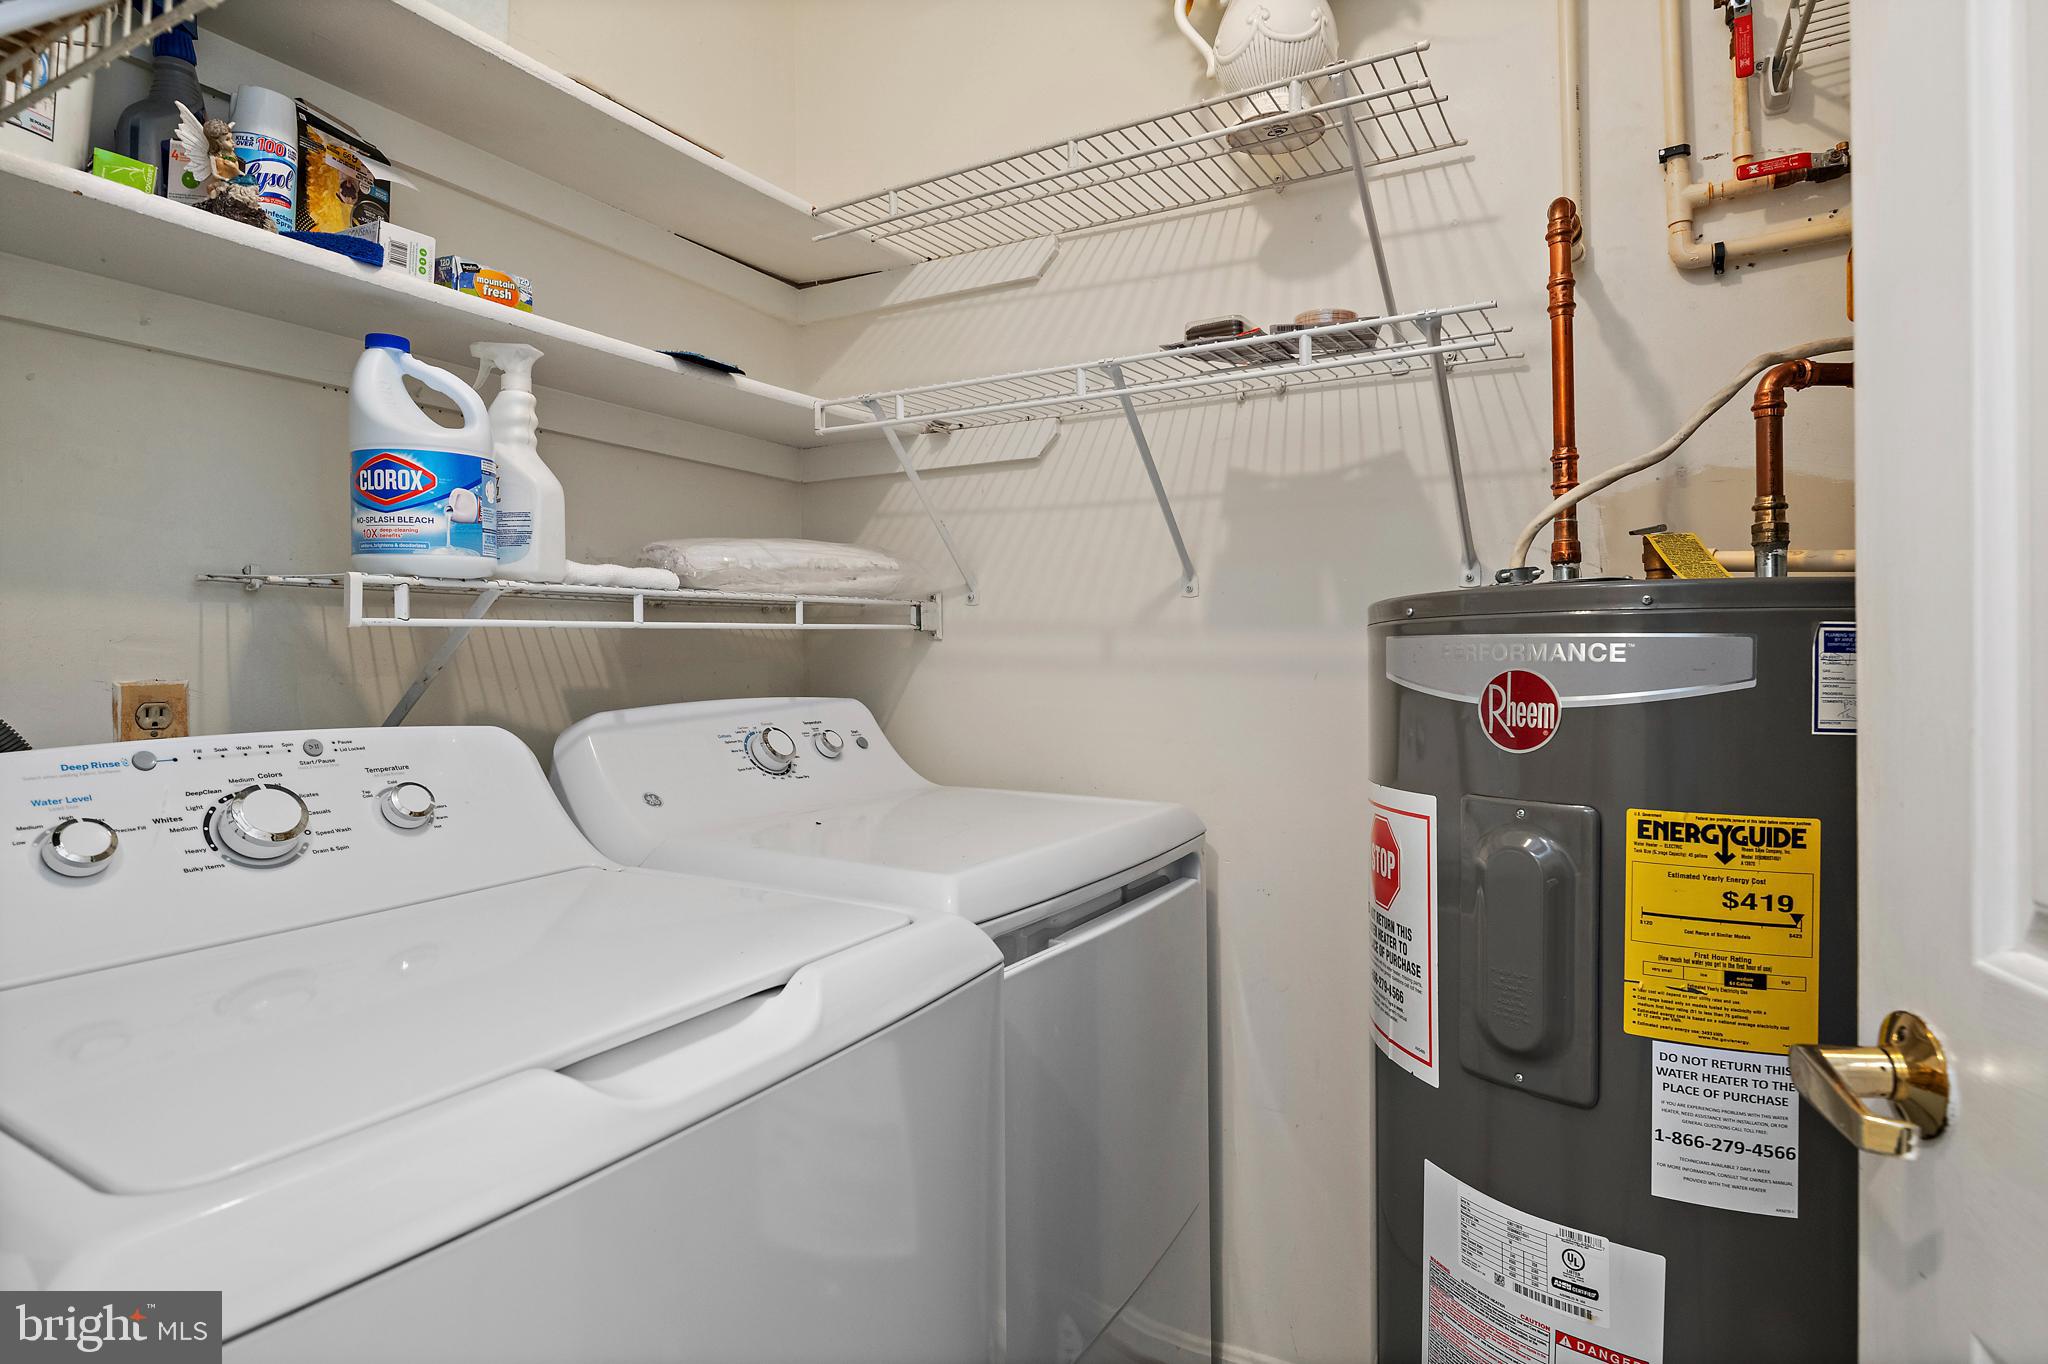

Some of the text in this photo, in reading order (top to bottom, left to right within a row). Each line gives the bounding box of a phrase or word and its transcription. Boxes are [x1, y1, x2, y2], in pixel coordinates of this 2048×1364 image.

[257, 137, 286, 157] 100
[171, 149, 179, 160] 4
[246, 162, 293, 195] Lysol
[440, 258, 450, 267] 120
[476, 276, 515, 290] mountain
[482, 285, 513, 300] fresh
[358, 469, 423, 491] CLOROX
[397, 516, 435, 525] BLEACH
[363, 528, 378, 538] 10X
[1488, 671, 1556, 738] Rheem
[60, 761, 121, 773] Deep Rinse
[299, 758, 336, 766] Start/Pause
[364, 764, 410, 774] Temperature
[228, 777, 255, 785] Medium
[257, 771, 283, 780] Colors
[185, 788, 223, 797] DeepClean
[30, 799, 62, 808] Water
[65, 795, 93, 804] Level
[185, 804, 204, 812] Light
[152, 816, 184, 825] Whites
[169, 825, 199, 833] Medium
[315, 829, 333, 837] Speed
[1637, 819, 1807, 850] ENERGYGUIDE
[184, 847, 207, 856] Heavy
[312, 847, 331, 855] Drain
[338, 844, 350, 852] Spin
[183, 862, 226, 874] Bulky Items
[1372, 844, 1396, 880] STOP
[1667, 872, 1700, 881] Estimated
[1702, 874, 1724, 883] Yearly
[1726, 876, 1750, 886] Energy
[1722, 890, 1794, 913] $419
[1377, 911, 1395, 934] RETURN
[1396, 922, 1412, 942] THIS
[1378, 925, 1397, 951] HEATER
[1399, 939, 1408, 956] TO
[1386, 949, 1422, 979] PURCHASE
[1712, 954, 1728, 962] Hour
[1730, 956, 1752, 964] Rating
[1659, 1051, 1791, 1076] DO NOT RETURN THIS
[1656, 1066, 1796, 1092] WATER HEATER TO THE
[1662, 1082, 1789, 1107] PLACE OF PURCHASE
[1687, 1104, 1720, 1113] EXPERIENCING
[1695, 1113, 1721, 1121] ASSISTANCE
[1704, 1122, 1731, 1130] QUESTIONS
[1655, 1128, 1796, 1160] 1-866-279-4566
[1680, 1156, 1710, 1166] TECHNICIANS
[1710, 1162, 1735, 1170] AVAILABLE
[1683, 1176, 1707, 1184] PROVIDED
[1717, 1172, 1739, 1180] CONSULT
[1567, 1251, 1580, 1268] UL
[1520, 1313, 1551, 1332] CAUTION
[1577, 1341, 1649, 1364] DANGE
